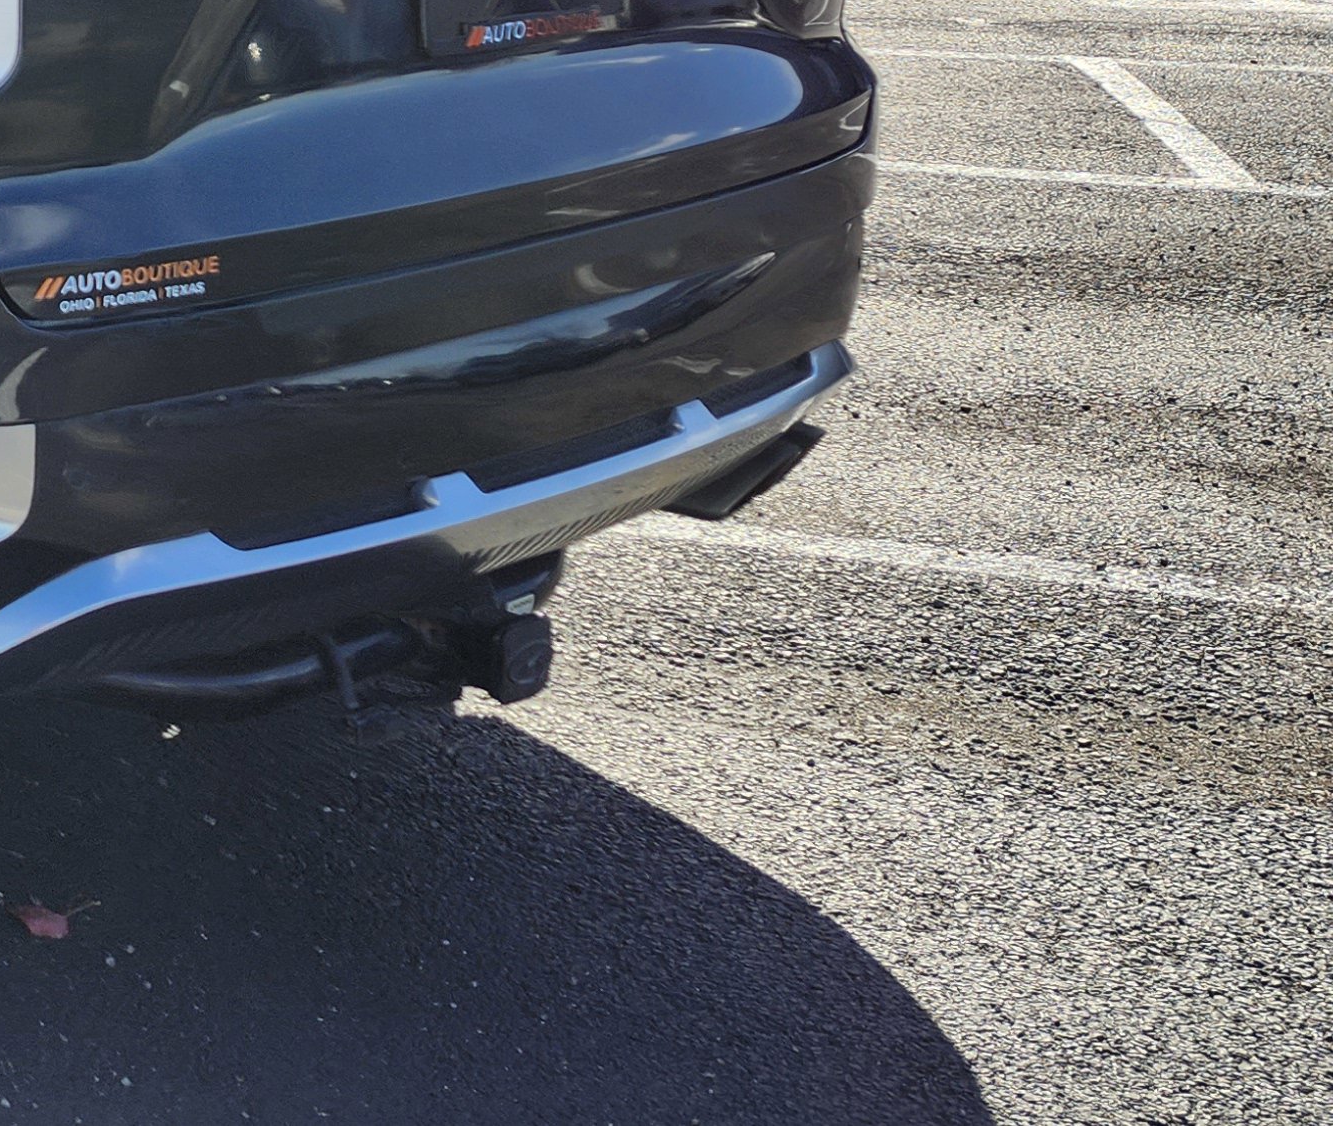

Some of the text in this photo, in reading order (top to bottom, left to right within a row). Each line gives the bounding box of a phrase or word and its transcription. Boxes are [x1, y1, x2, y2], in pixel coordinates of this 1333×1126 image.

[59, 281, 206, 314] OHIO FLORIDA TEXAS
